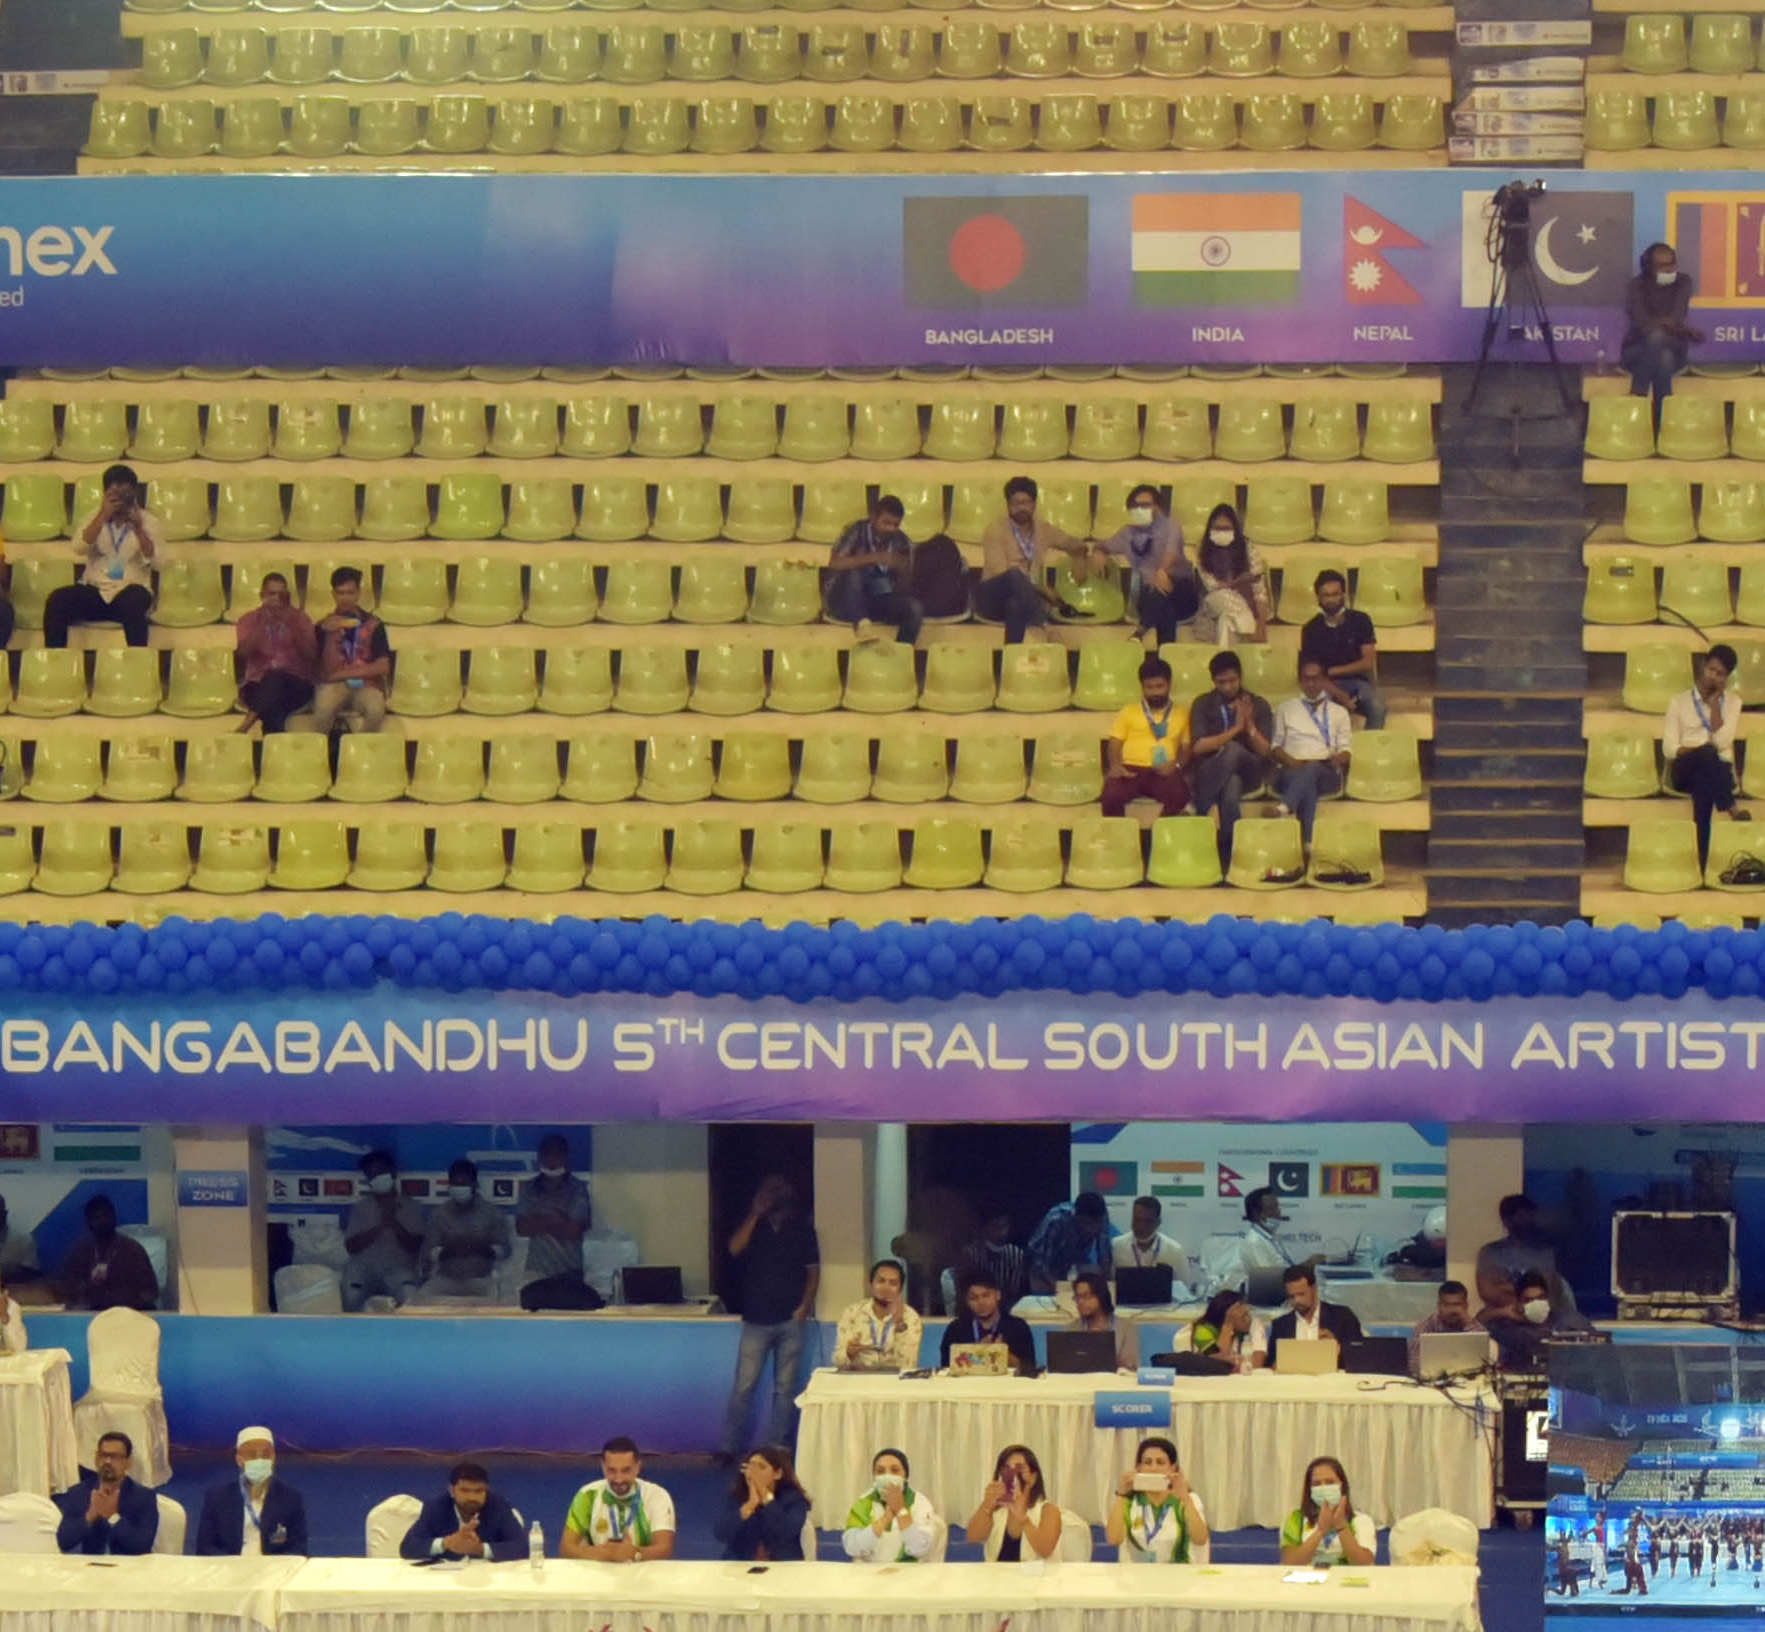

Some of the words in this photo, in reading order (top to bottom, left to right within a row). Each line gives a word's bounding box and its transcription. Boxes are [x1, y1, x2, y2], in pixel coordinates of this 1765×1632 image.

[925, 328, 1054, 345] BANGLADESH
[1192, 327, 1245, 342] INDIA
[1353, 325, 1413, 341] NEPAL
[1511, 325, 1600, 342] AKSTAN
[1714, 326, 1745, 342] SRI
[0, 1017, 589, 1074] BANGABANDHU
[613, 1016, 705, 1071] 5TH
[717, 1021, 1029, 1071] CENTRAL
[1043, 1021, 1268, 1071] SOUTH
[1281, 1021, 1484, 1071] ASIAN
[192, 1190, 234, 1201] ZONE
[1111, 1403, 1154, 1414] SCORER
